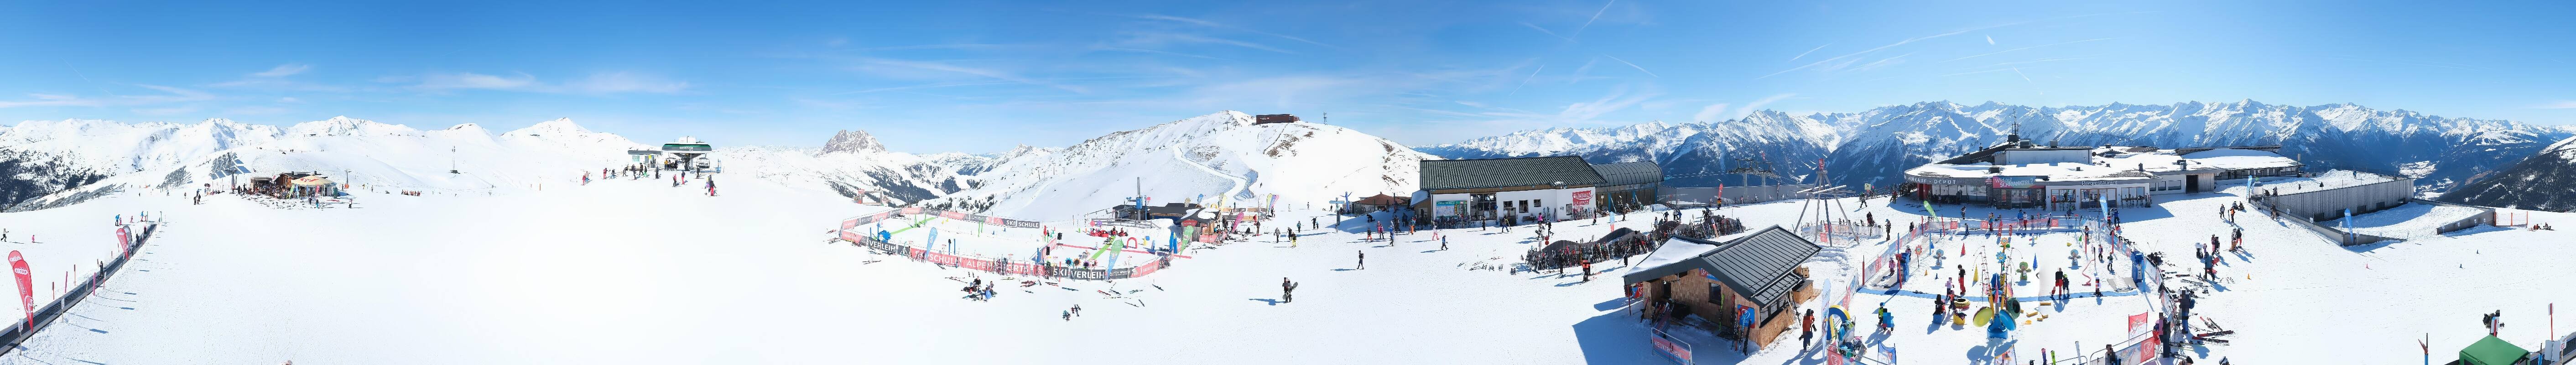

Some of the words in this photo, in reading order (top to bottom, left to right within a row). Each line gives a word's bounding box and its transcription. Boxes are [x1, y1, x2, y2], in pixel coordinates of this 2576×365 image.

[869, 240, 895, 251] VERLEIH
[1071, 271, 1104, 279] VERLEIH
[1654, 339, 1681, 359] NEUKIRCHEN
